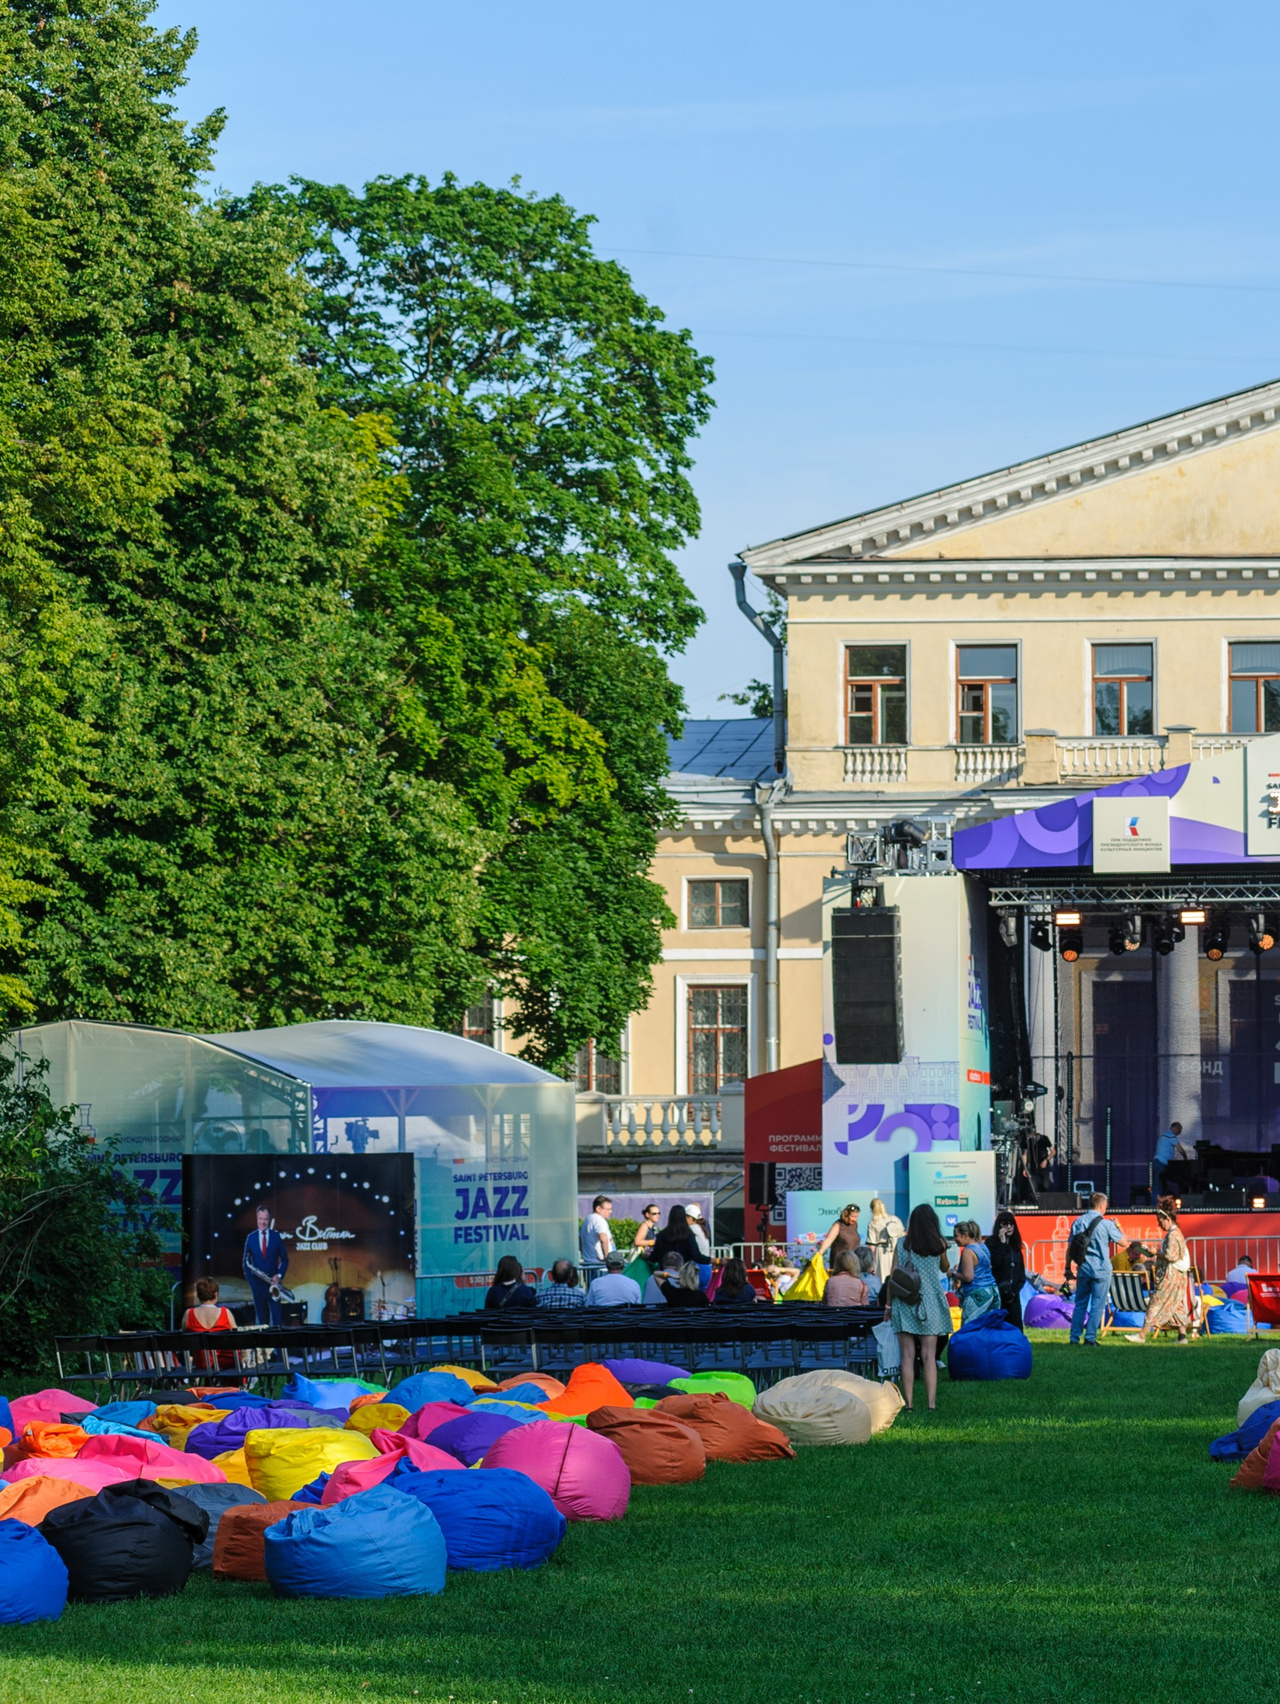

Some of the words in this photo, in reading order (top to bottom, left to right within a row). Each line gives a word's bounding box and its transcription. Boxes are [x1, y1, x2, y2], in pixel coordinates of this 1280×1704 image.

[453, 1173, 476, 1183] SAINT
[479, 1171, 528, 1182] PETERSBURG
[454, 1185, 529, 1220] JAZZ
[453, 1223, 529, 1245] FESTIVAL
[296, 1242, 311, 1250] JAZZ
[312, 1242, 328, 1250] CLUB
